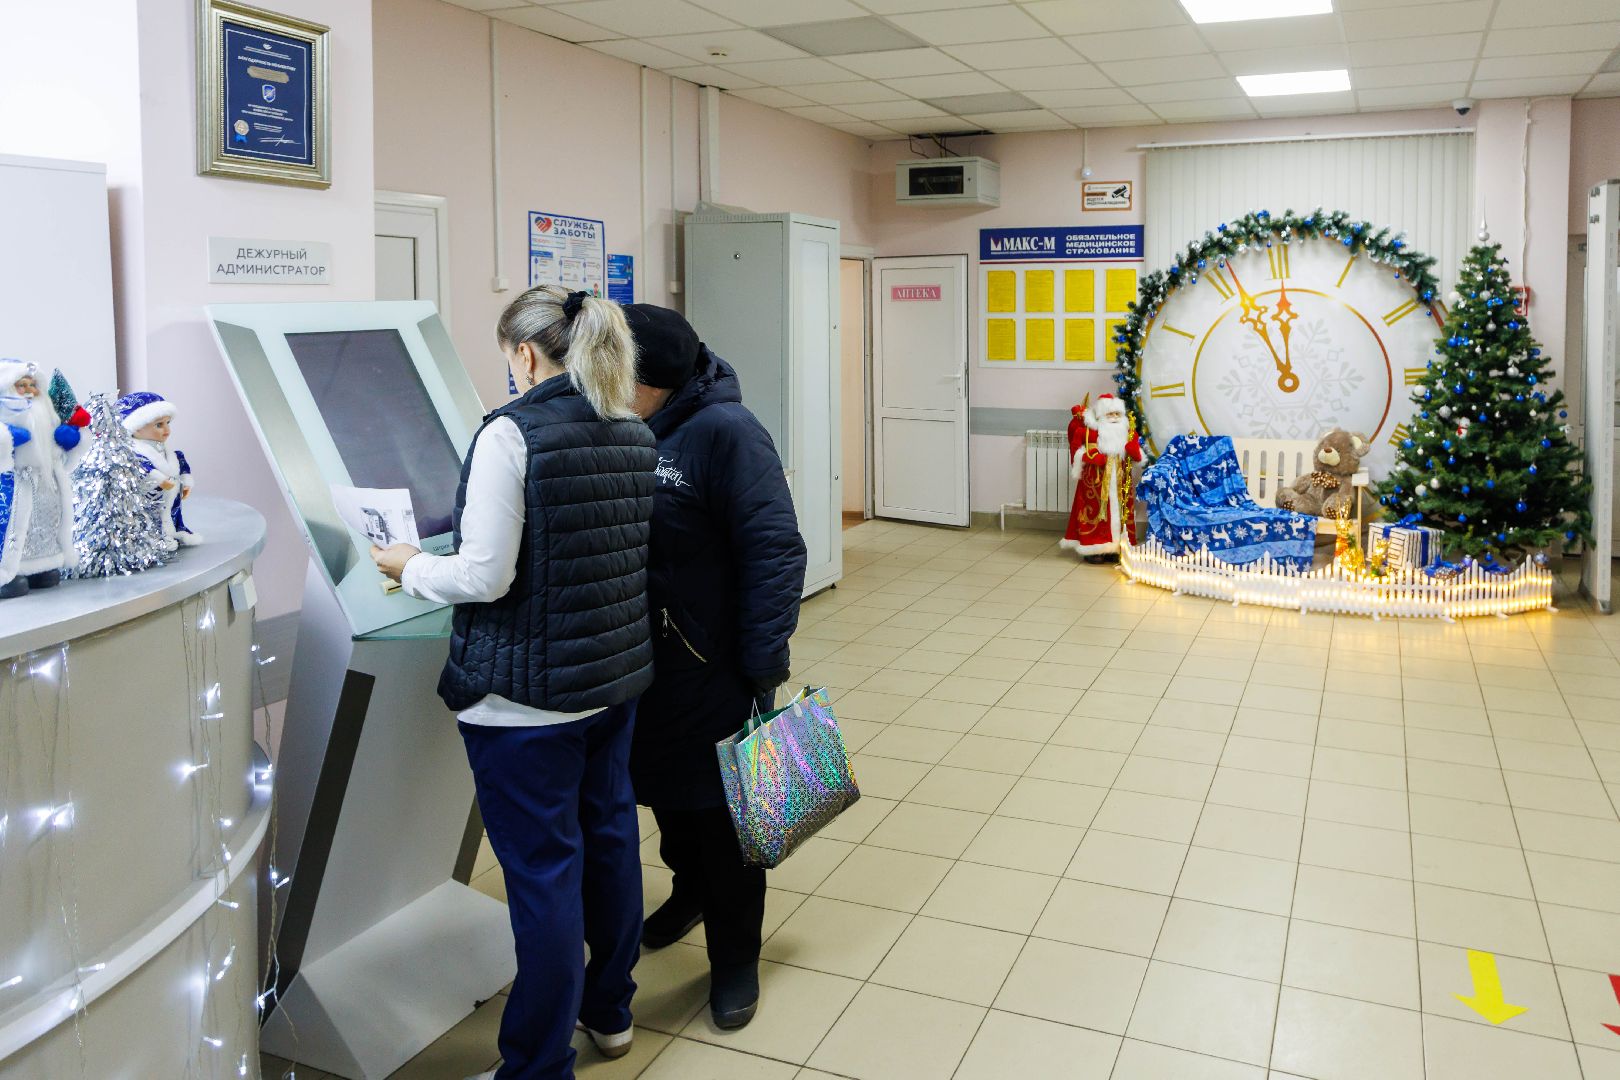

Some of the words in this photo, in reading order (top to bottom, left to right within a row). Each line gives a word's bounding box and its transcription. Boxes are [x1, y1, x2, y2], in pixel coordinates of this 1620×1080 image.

[553, 218, 595, 231] СЛУЖБА
[553, 227, 596, 240] ЗАБОТЫ
[1065, 233, 1136, 241] ОБЯЗАТЕЛЬНОЕ
[1003, 236, 1056, 250] МАКС-М
[236, 246, 307, 260] ДЕЖУРНЫЙ
[1065, 247, 1136, 255] СТРАХОВАНИЕ
[216, 263, 326, 276] АДМИНИСТРАТОР
[896, 287, 937, 298] АПТЕКА
